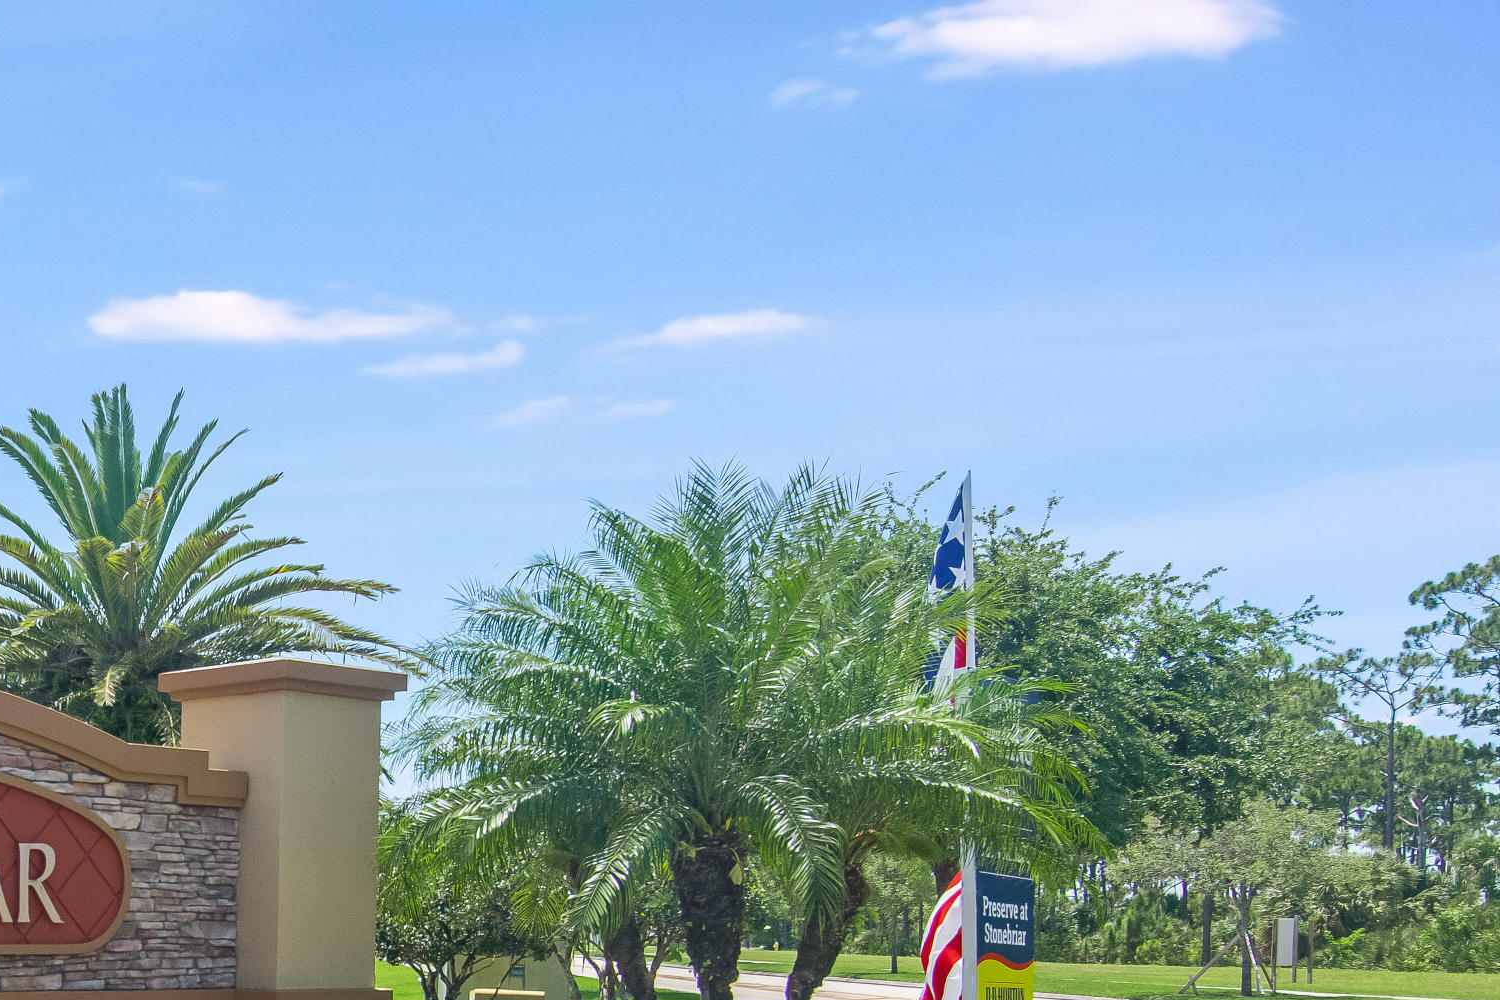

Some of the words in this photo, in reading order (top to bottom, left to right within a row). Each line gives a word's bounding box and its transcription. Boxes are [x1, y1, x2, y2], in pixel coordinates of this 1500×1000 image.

[982, 895, 1019, 920] Preserve
[1019, 902, 1029, 921] at
[984, 922, 1027, 946] Stonebriar
